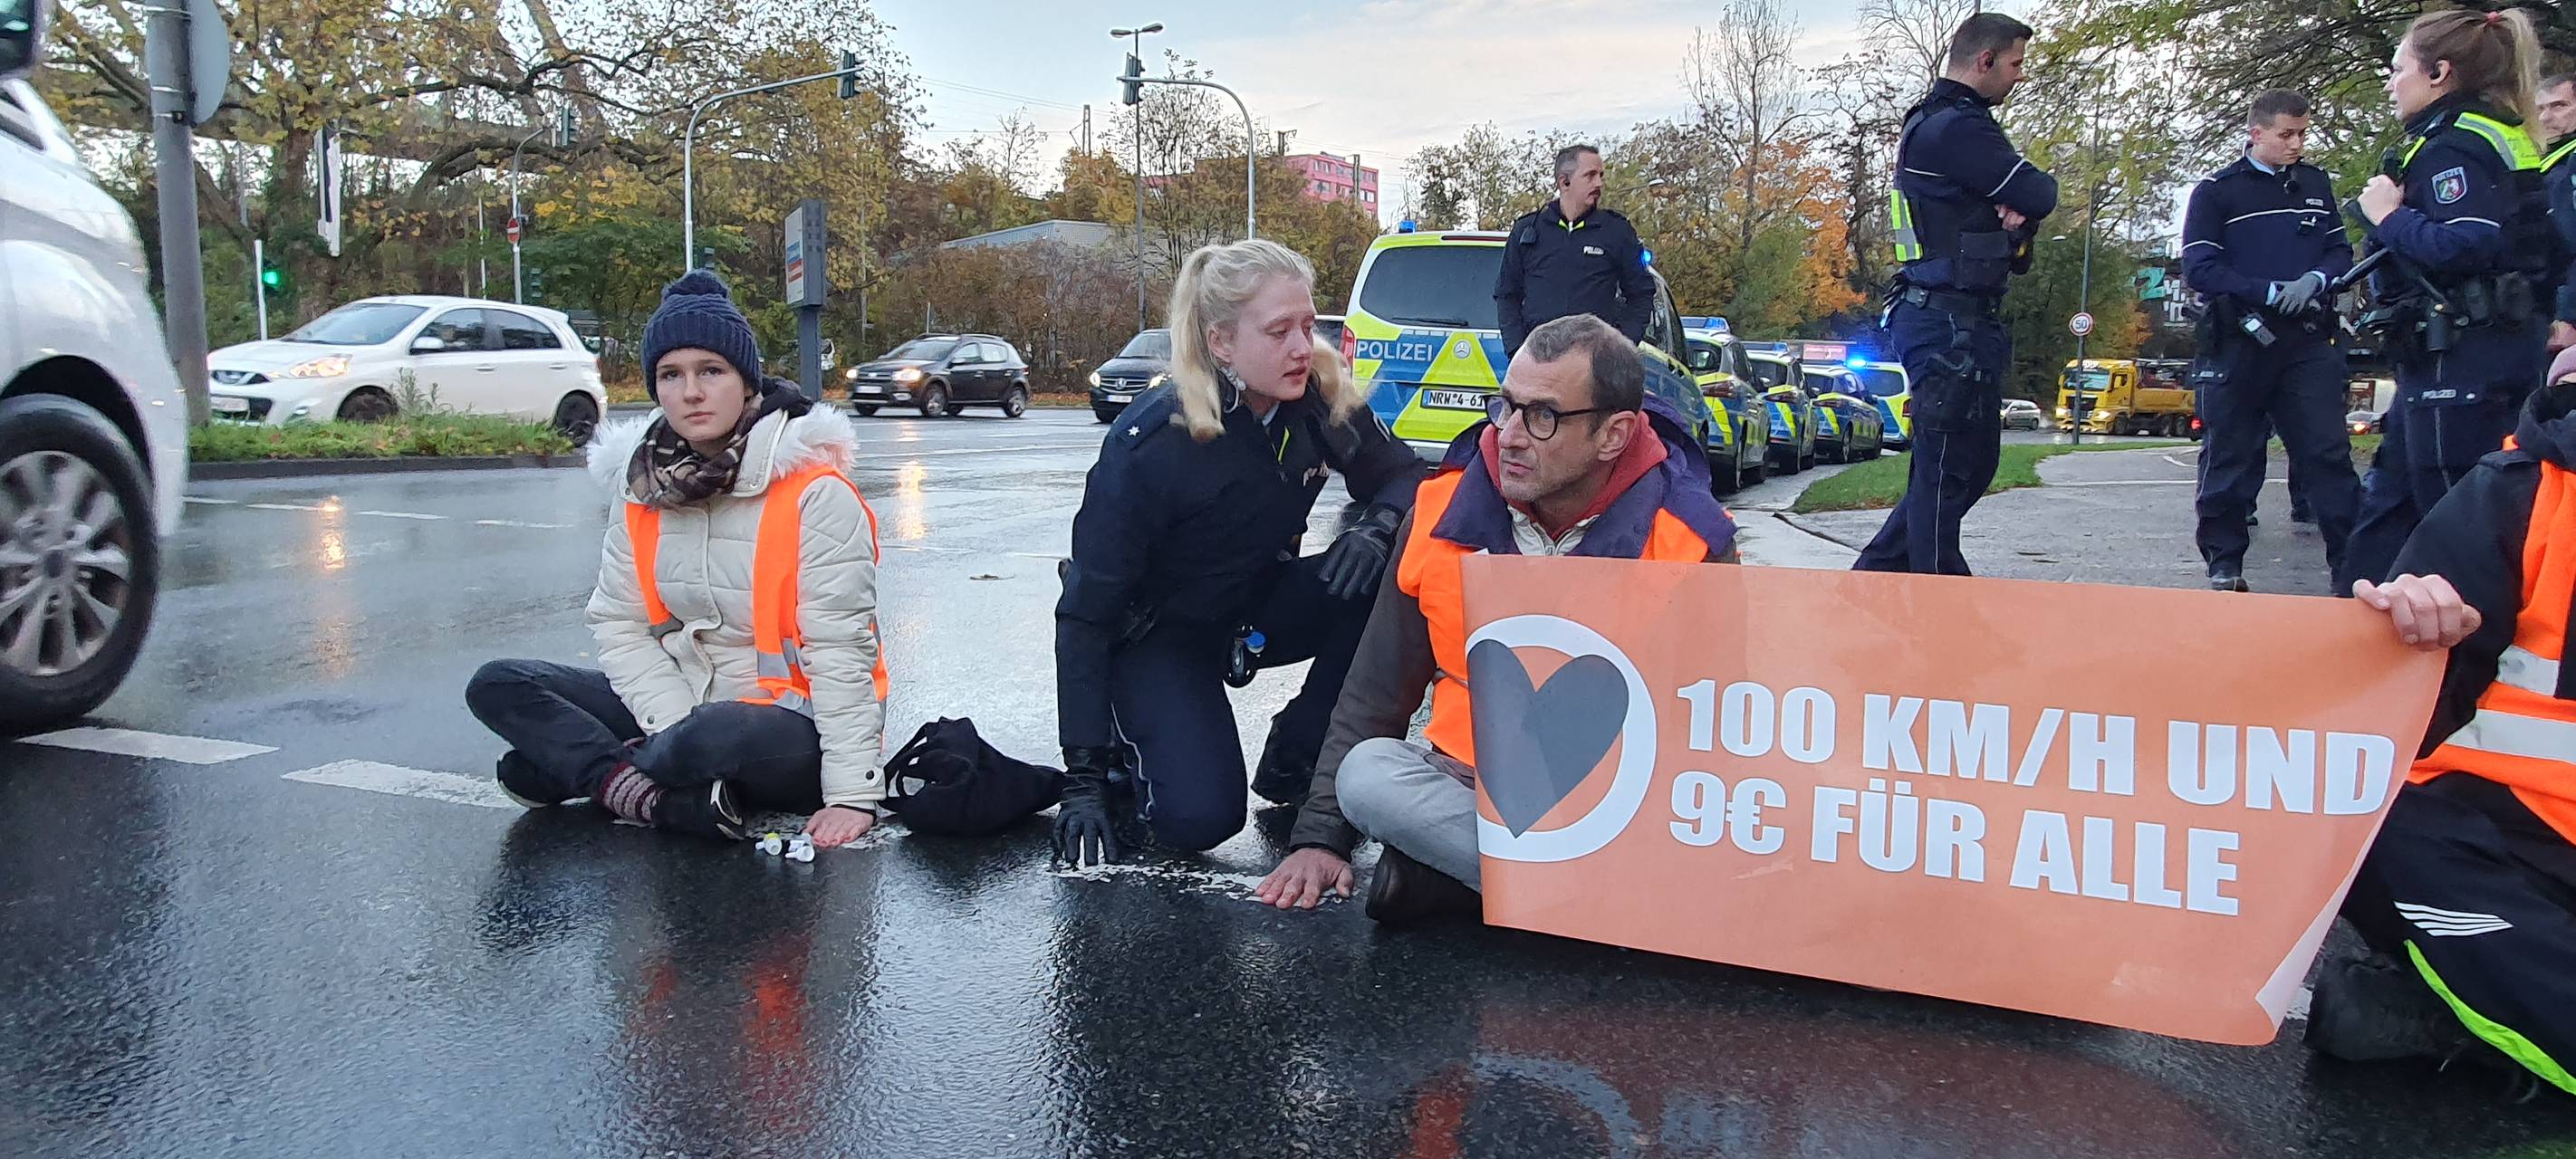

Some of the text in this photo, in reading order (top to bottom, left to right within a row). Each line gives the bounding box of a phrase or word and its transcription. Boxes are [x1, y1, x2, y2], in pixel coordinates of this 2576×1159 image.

[2075, 319, 2088, 330] 50
[1356, 340, 1433, 362] POLIZEI
[1428, 392, 1484, 407] NRW 4-61
[1677, 678, 2396, 815] 100 KM/H UND
[1668, 770, 2240, 916] 9€ FÜR ALLE
